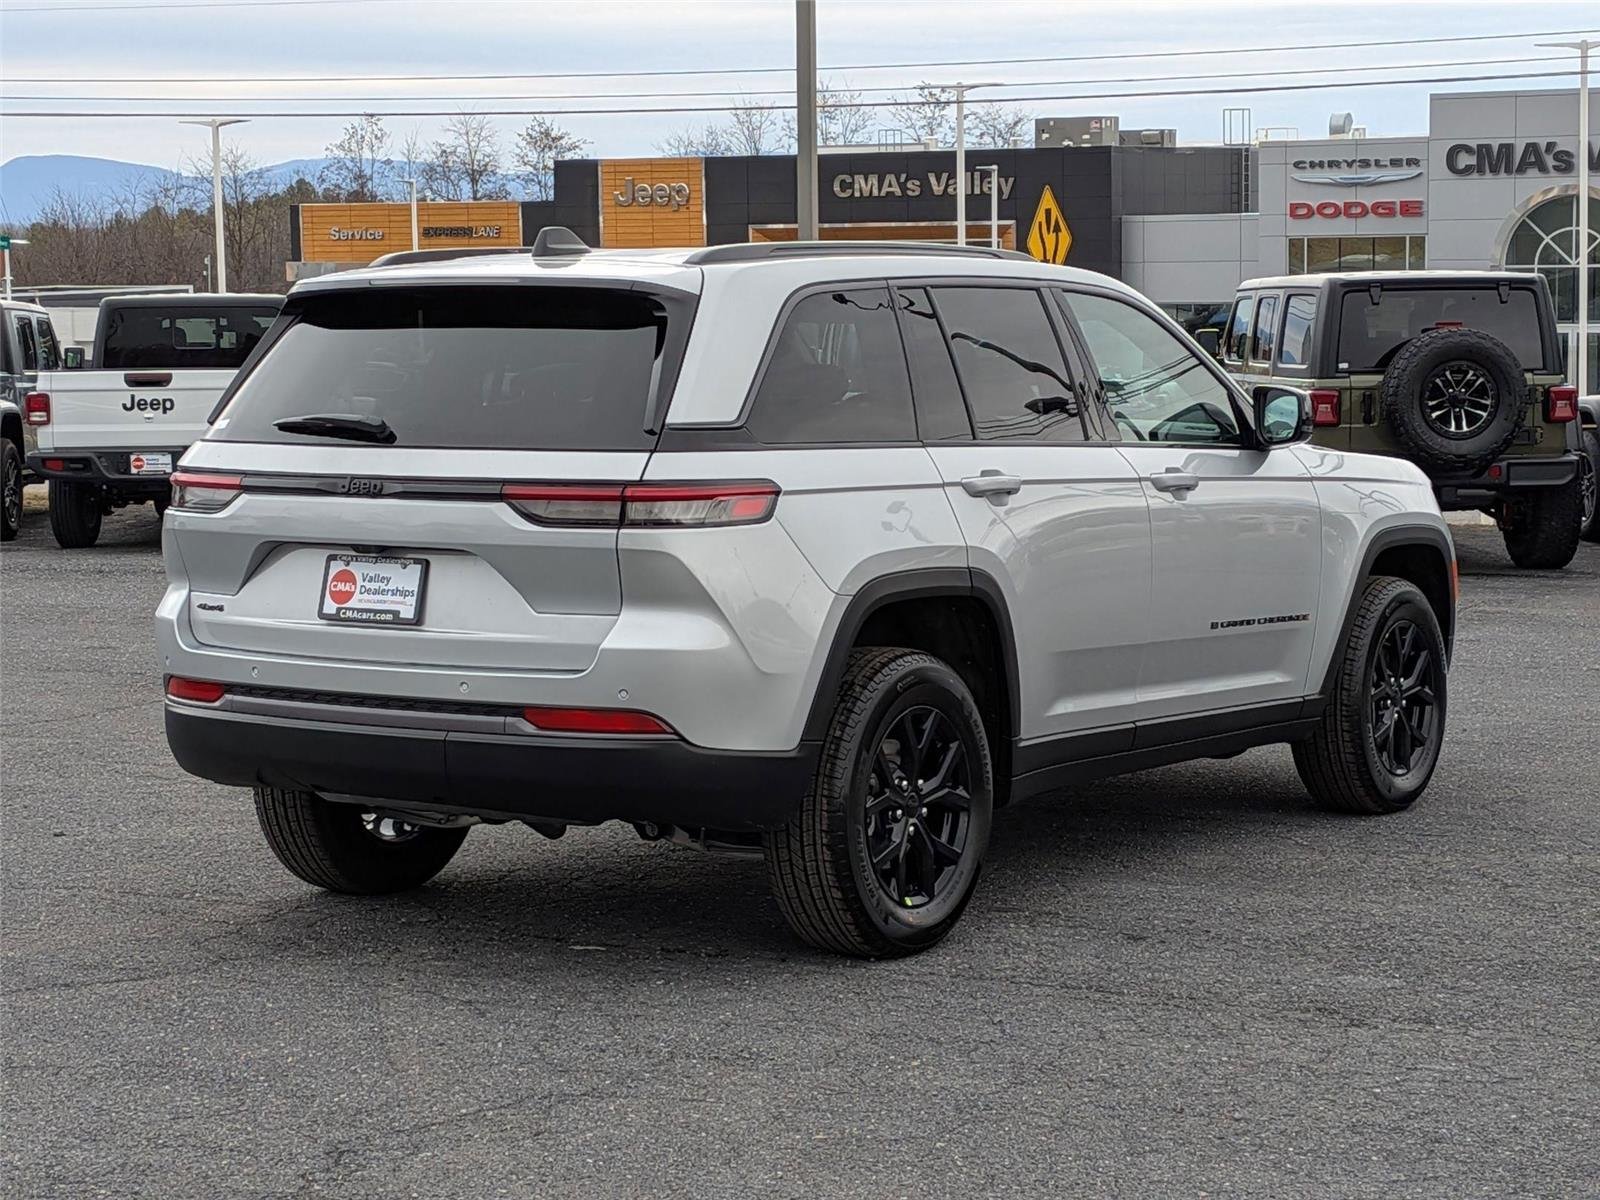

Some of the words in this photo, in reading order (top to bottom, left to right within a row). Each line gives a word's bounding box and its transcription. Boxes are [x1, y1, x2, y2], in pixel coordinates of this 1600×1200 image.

[1293, 157, 1421, 170] CHRYSLER
[1446, 141, 1576, 177] CMA's
[614, 177, 690, 211] Jeep
[833, 173, 921, 198] CMA's
[928, 172, 1015, 200] Valley
[1289, 200, 1424, 219] DODGE
[329, 226, 384, 241] Service
[121, 394, 175, 414] Jeep
[340, 476, 384, 495] Jeep
[330, 581, 356, 592] CMA's
[361, 572, 392, 586] Valley
[359, 585, 415, 599] Dealerships
[339, 609, 394, 620] CMAcars.com
